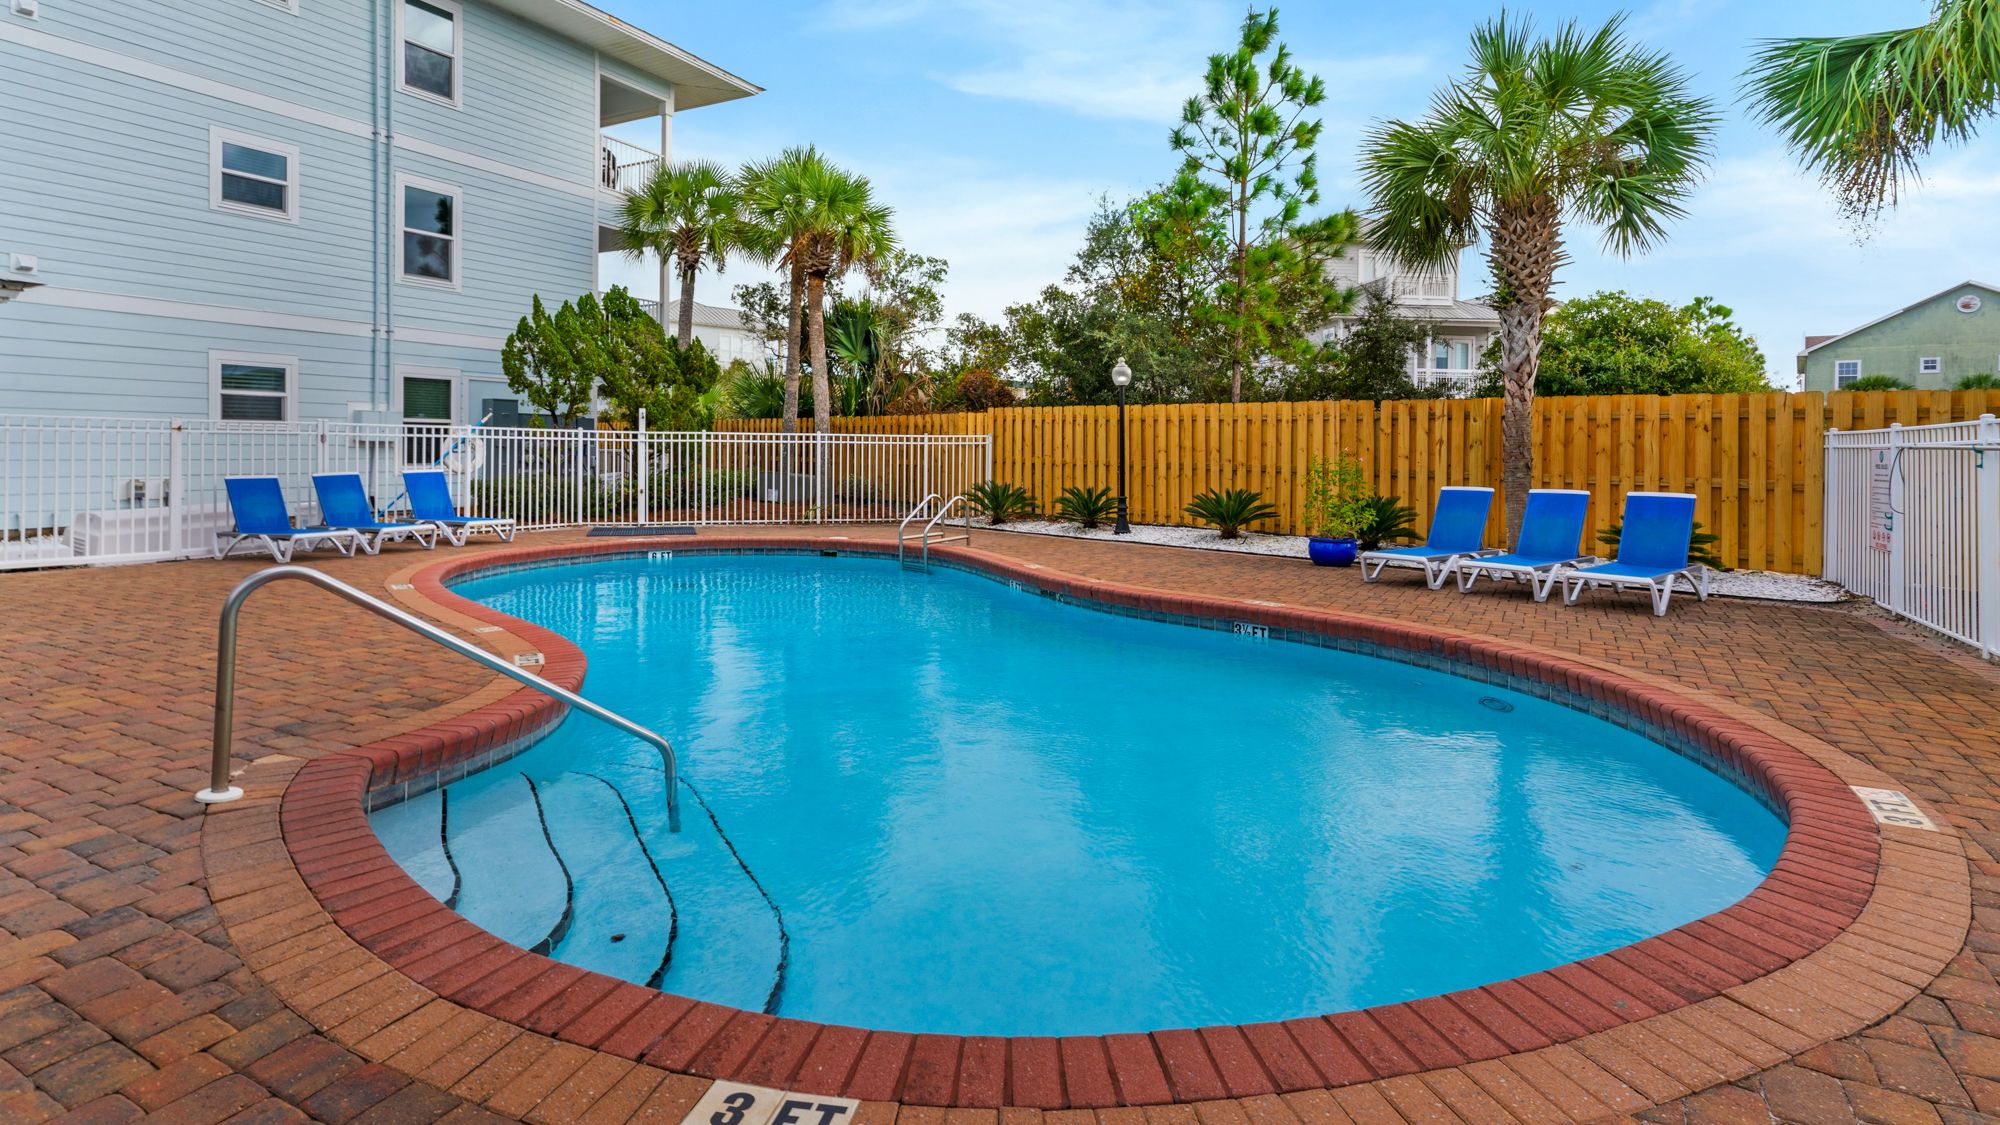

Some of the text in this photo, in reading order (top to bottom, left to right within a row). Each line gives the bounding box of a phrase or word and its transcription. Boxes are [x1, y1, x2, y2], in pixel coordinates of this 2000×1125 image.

[1252, 626, 1266, 637] FT
[1870, 800, 1917, 815] FT
[1883, 815, 1924, 825] 3
[710, 1092, 849, 1125] 3 FT
